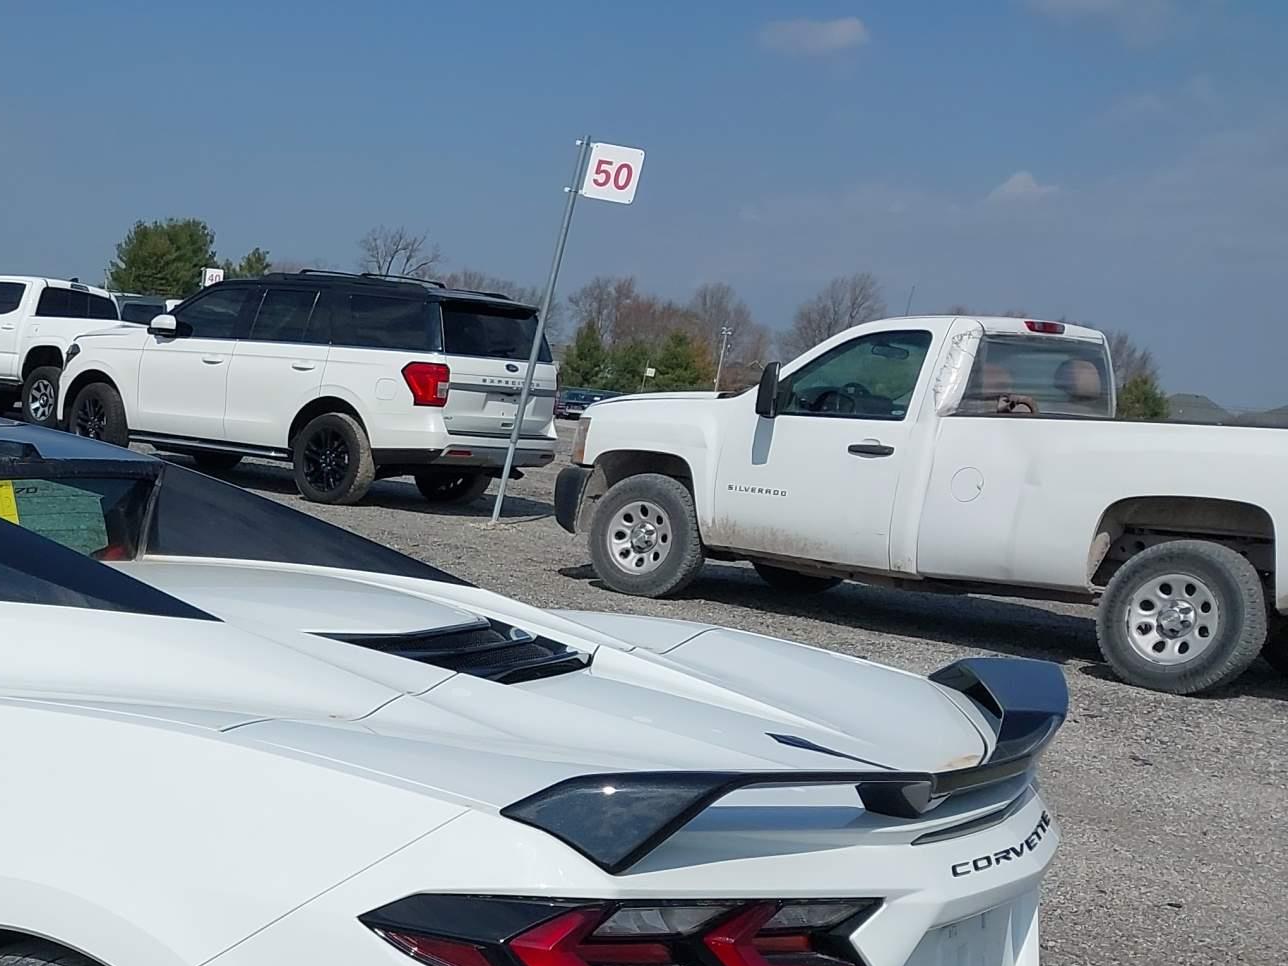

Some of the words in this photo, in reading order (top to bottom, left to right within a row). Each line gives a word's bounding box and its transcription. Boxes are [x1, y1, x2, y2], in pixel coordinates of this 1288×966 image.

[592, 159, 633, 190] 50
[727, 484, 787, 497] SILVERADO
[951, 810, 1051, 878] CORVETTE
